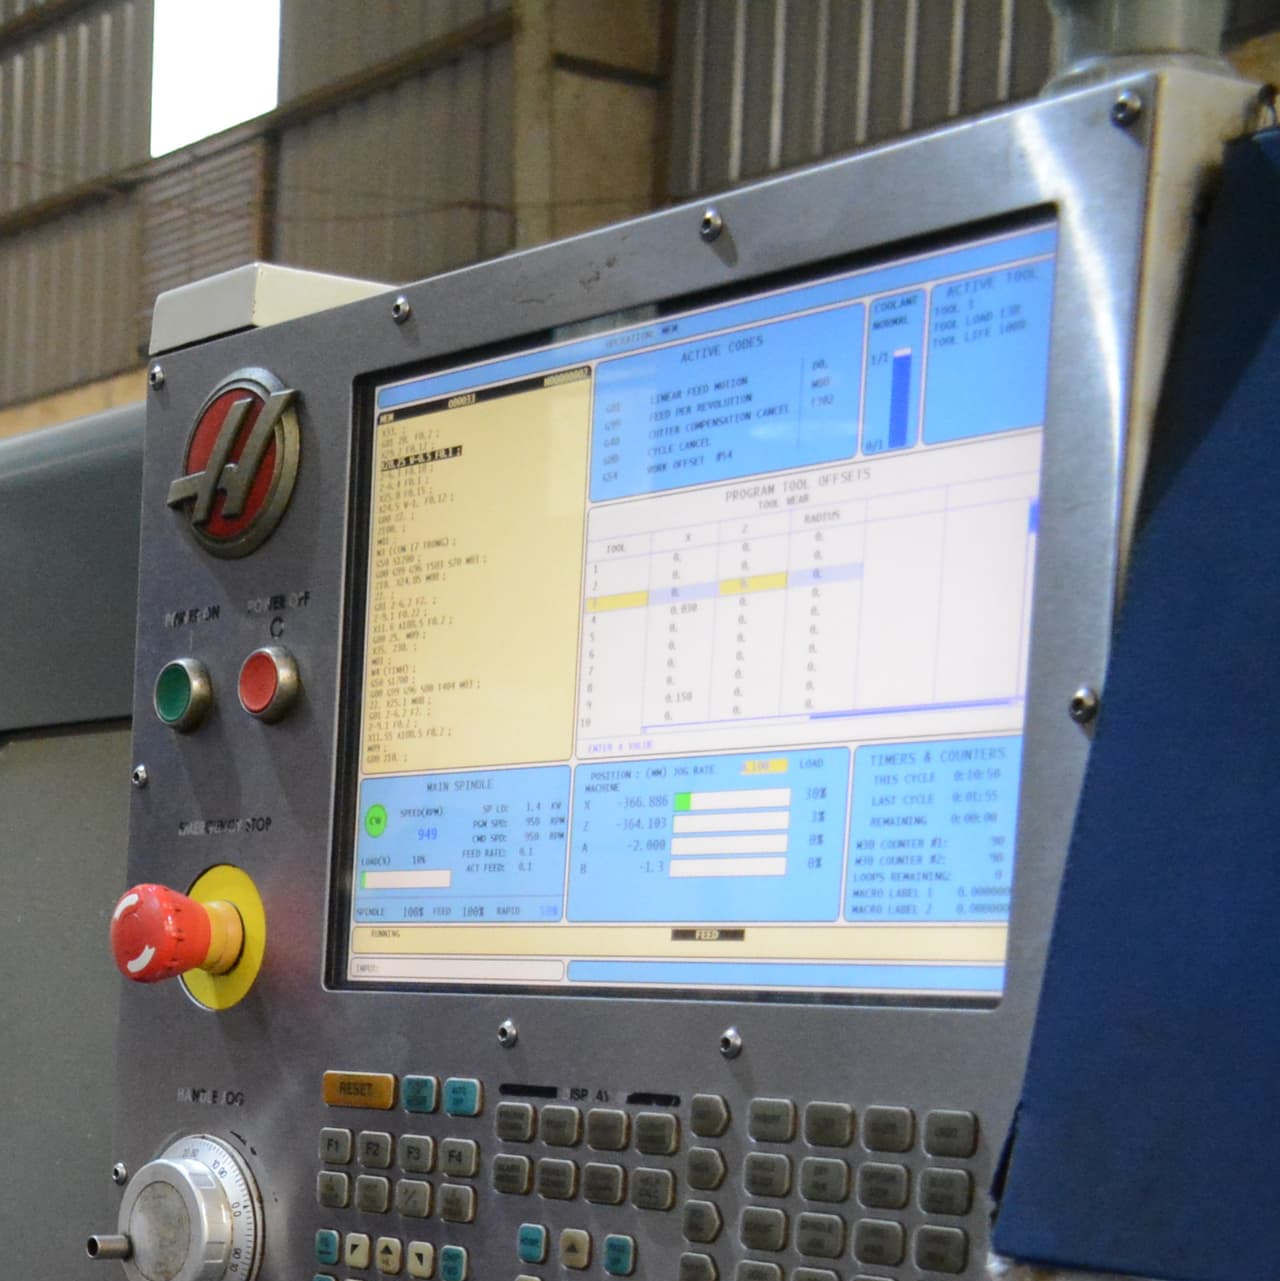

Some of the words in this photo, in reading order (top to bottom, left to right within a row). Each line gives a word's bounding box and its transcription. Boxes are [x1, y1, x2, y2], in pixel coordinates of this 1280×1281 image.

[681, 346, 720, 363] ACTIVE
[728, 336, 763, 353] CODES
[725, 484, 775, 502] PROGRAM
[818, 468, 871, 487] OFFSETS
[871, 753, 916, 766] TIMERS
[940, 748, 1006, 762] COUNTERS
[427, 782, 449, 792] MAIN
[454, 779, 492, 790] SPINDLE
[418, 828, 438, 840] 949
[338, 1082, 374, 1097] RESET
[327, 1139, 339, 1153] F1
[366, 1143, 380, 1157] F2
[407, 1146, 421, 1161] F3
[448, 1150, 463, 1164] F4
